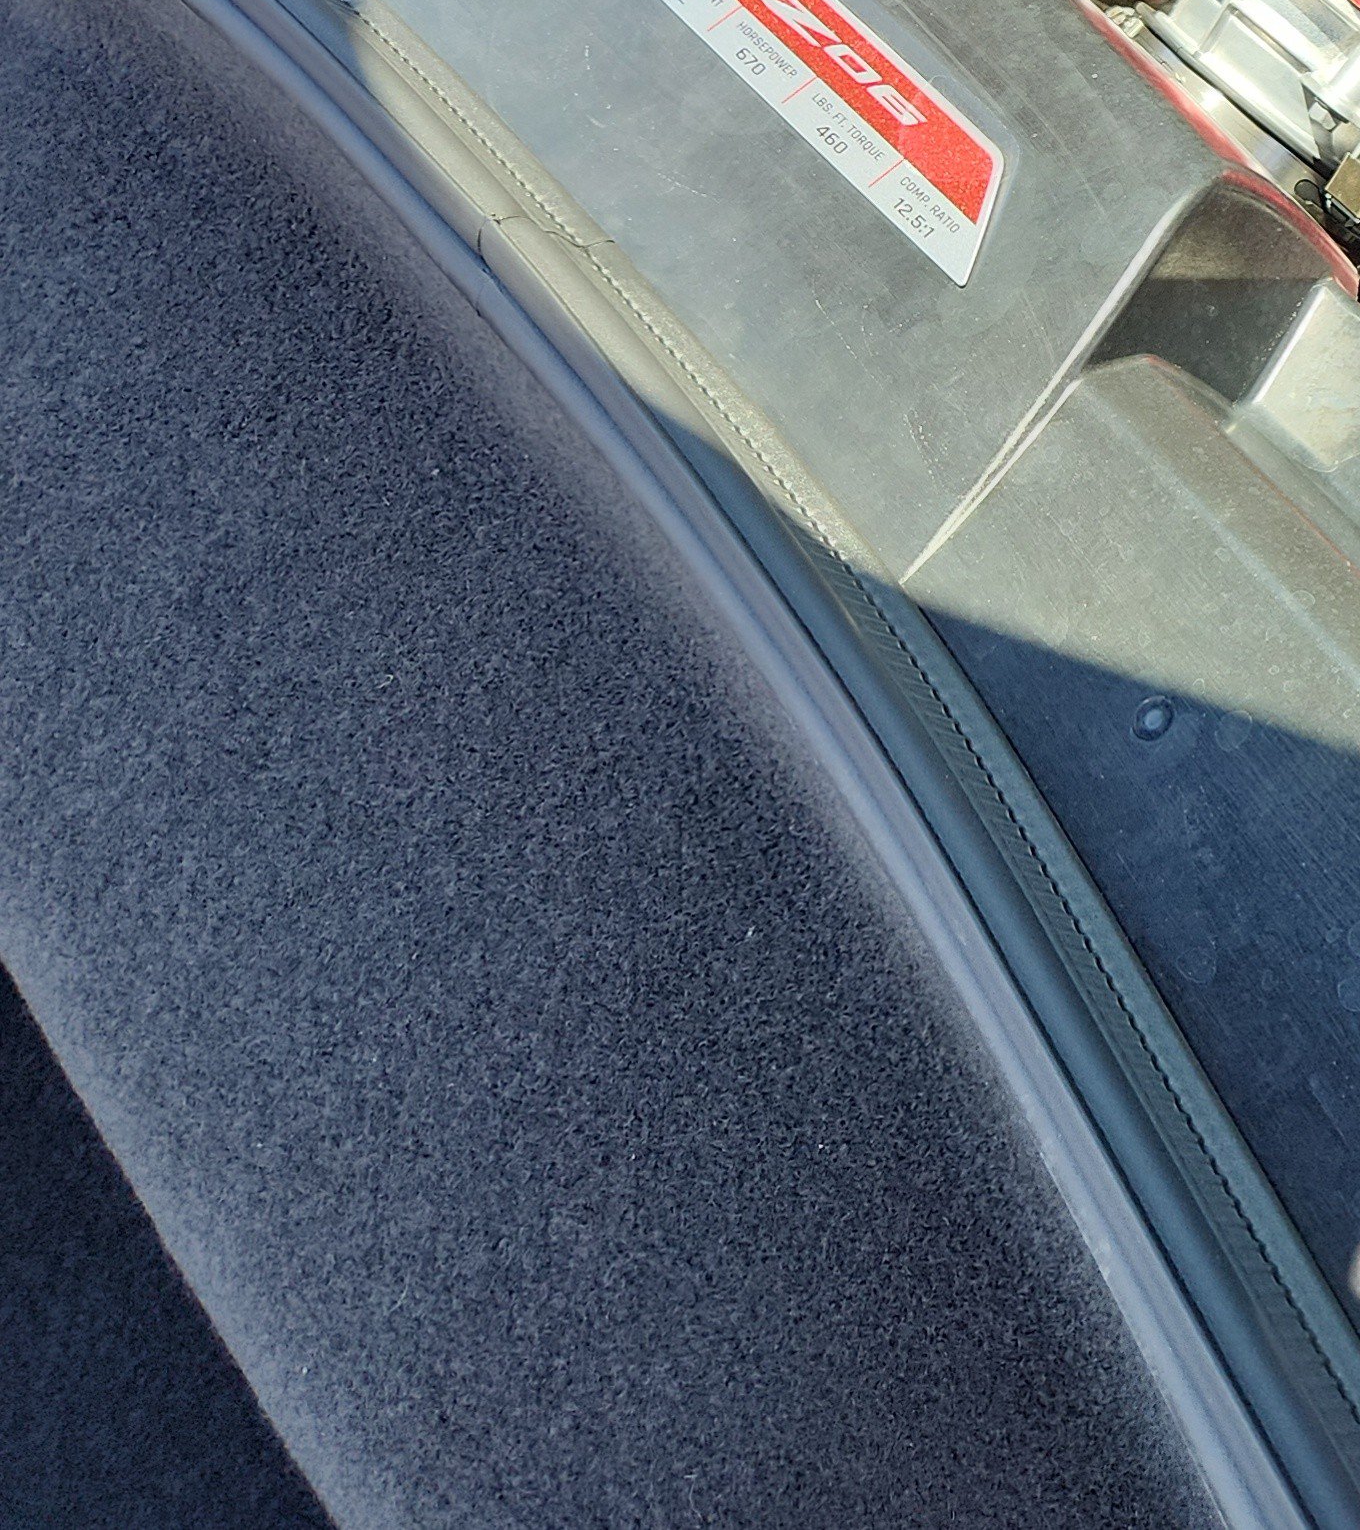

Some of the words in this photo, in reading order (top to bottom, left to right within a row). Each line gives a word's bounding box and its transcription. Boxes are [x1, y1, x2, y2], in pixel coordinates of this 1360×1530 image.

[735, 47, 767, 76] 670
[736, 21, 798, 78] HORSEPOWER
[811, 92, 834, 115] LBS.
[832, 112, 848, 128] FT.
[847, 125, 886, 162] TORQUE
[816, 126, 848, 154] 460
[893, 197, 935, 239] 12.5:1
[900, 176, 931, 208] COMP.
[929, 204, 961, 234] RATIO
